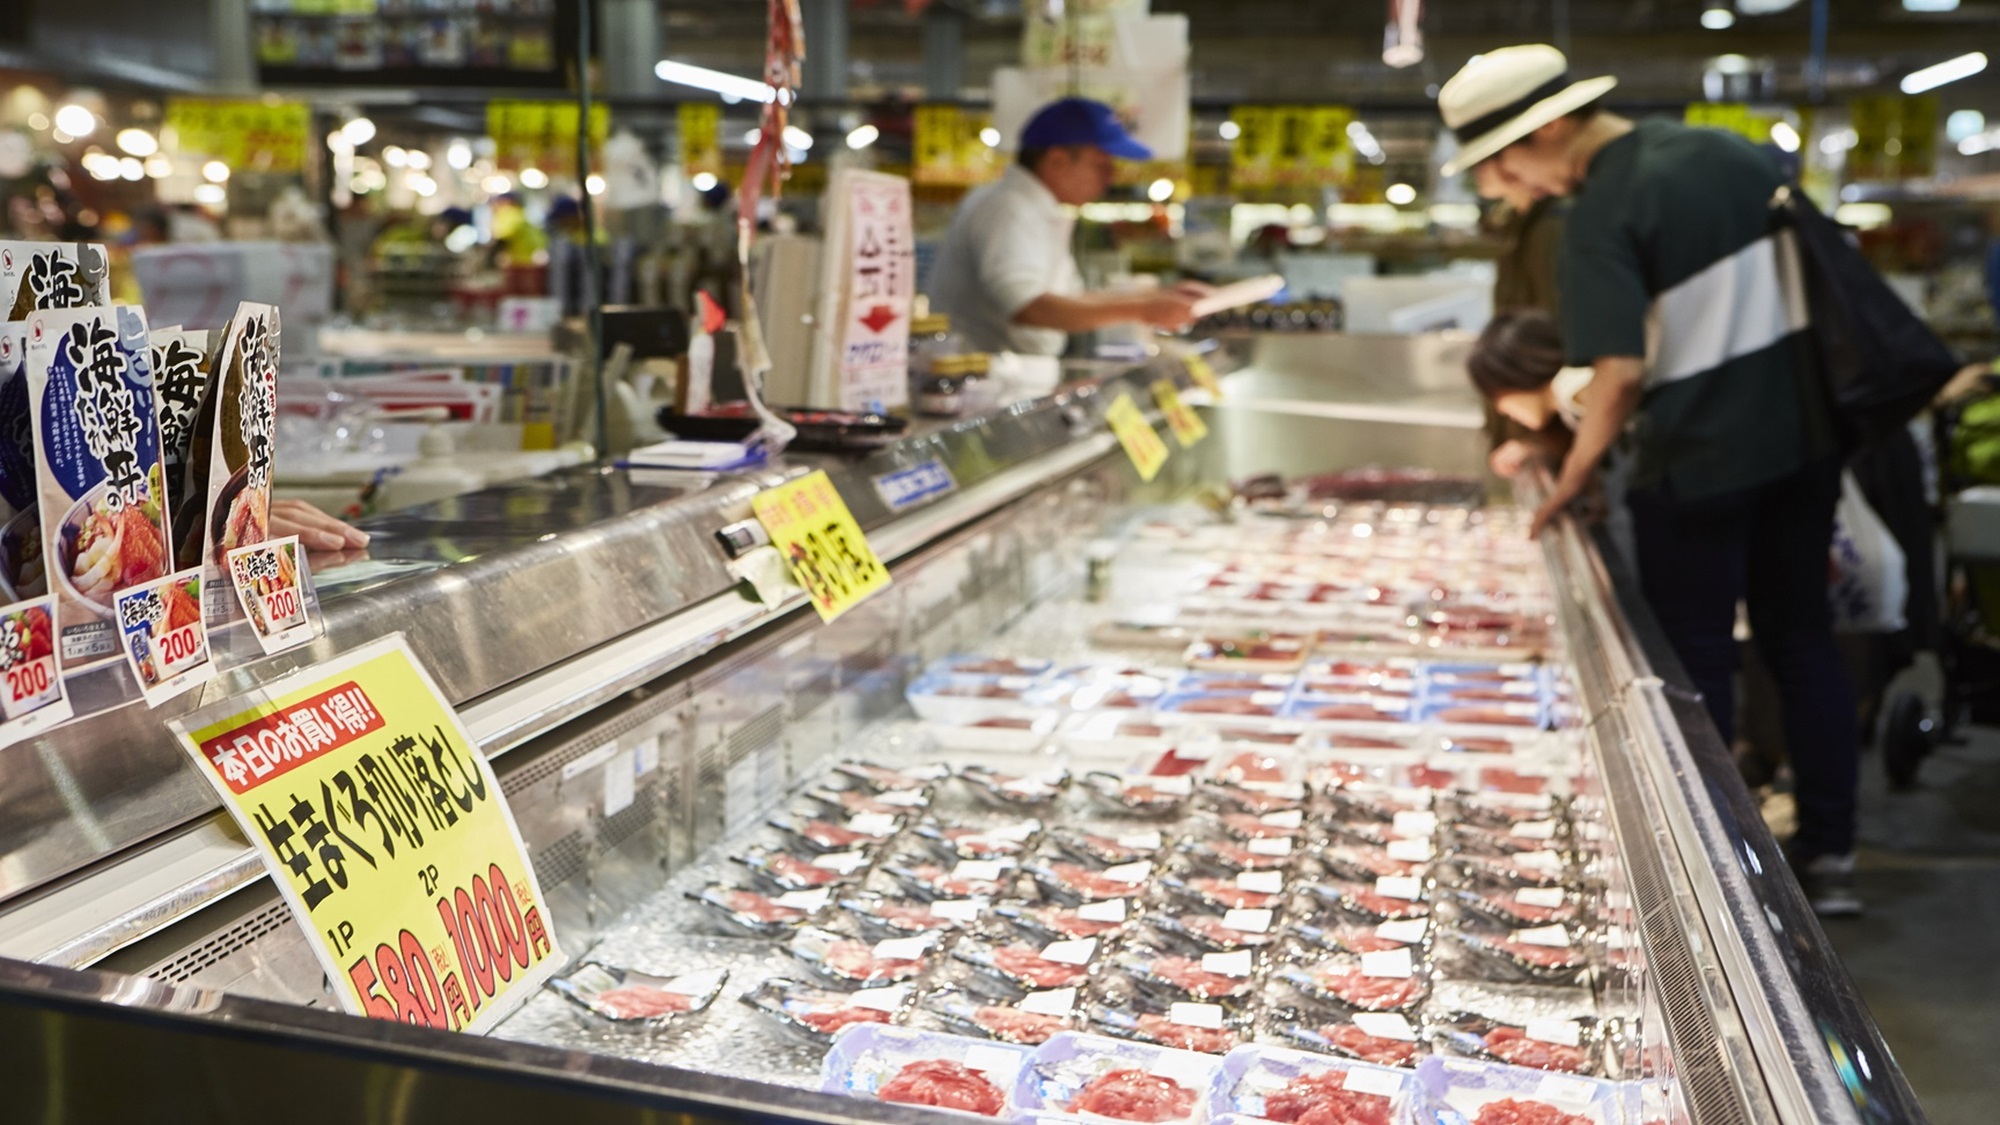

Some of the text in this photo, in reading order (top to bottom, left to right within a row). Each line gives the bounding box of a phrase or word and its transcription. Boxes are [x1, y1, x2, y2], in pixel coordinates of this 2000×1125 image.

[267, 591, 294, 621] 200
[160, 628, 195, 666] 200
[7, 662, 47, 702] 200
[212, 687, 377, 787] 本日のお買い得!!
[253, 725, 487, 913] 生まぐろ切り落とし
[418, 864, 440, 897] 2P
[328, 920, 355, 958] 1P
[437, 862, 529, 1012] 1000
[524, 905, 551, 961] 円
[349, 928, 449, 1031] 580
[442, 971, 471, 1032] 円
